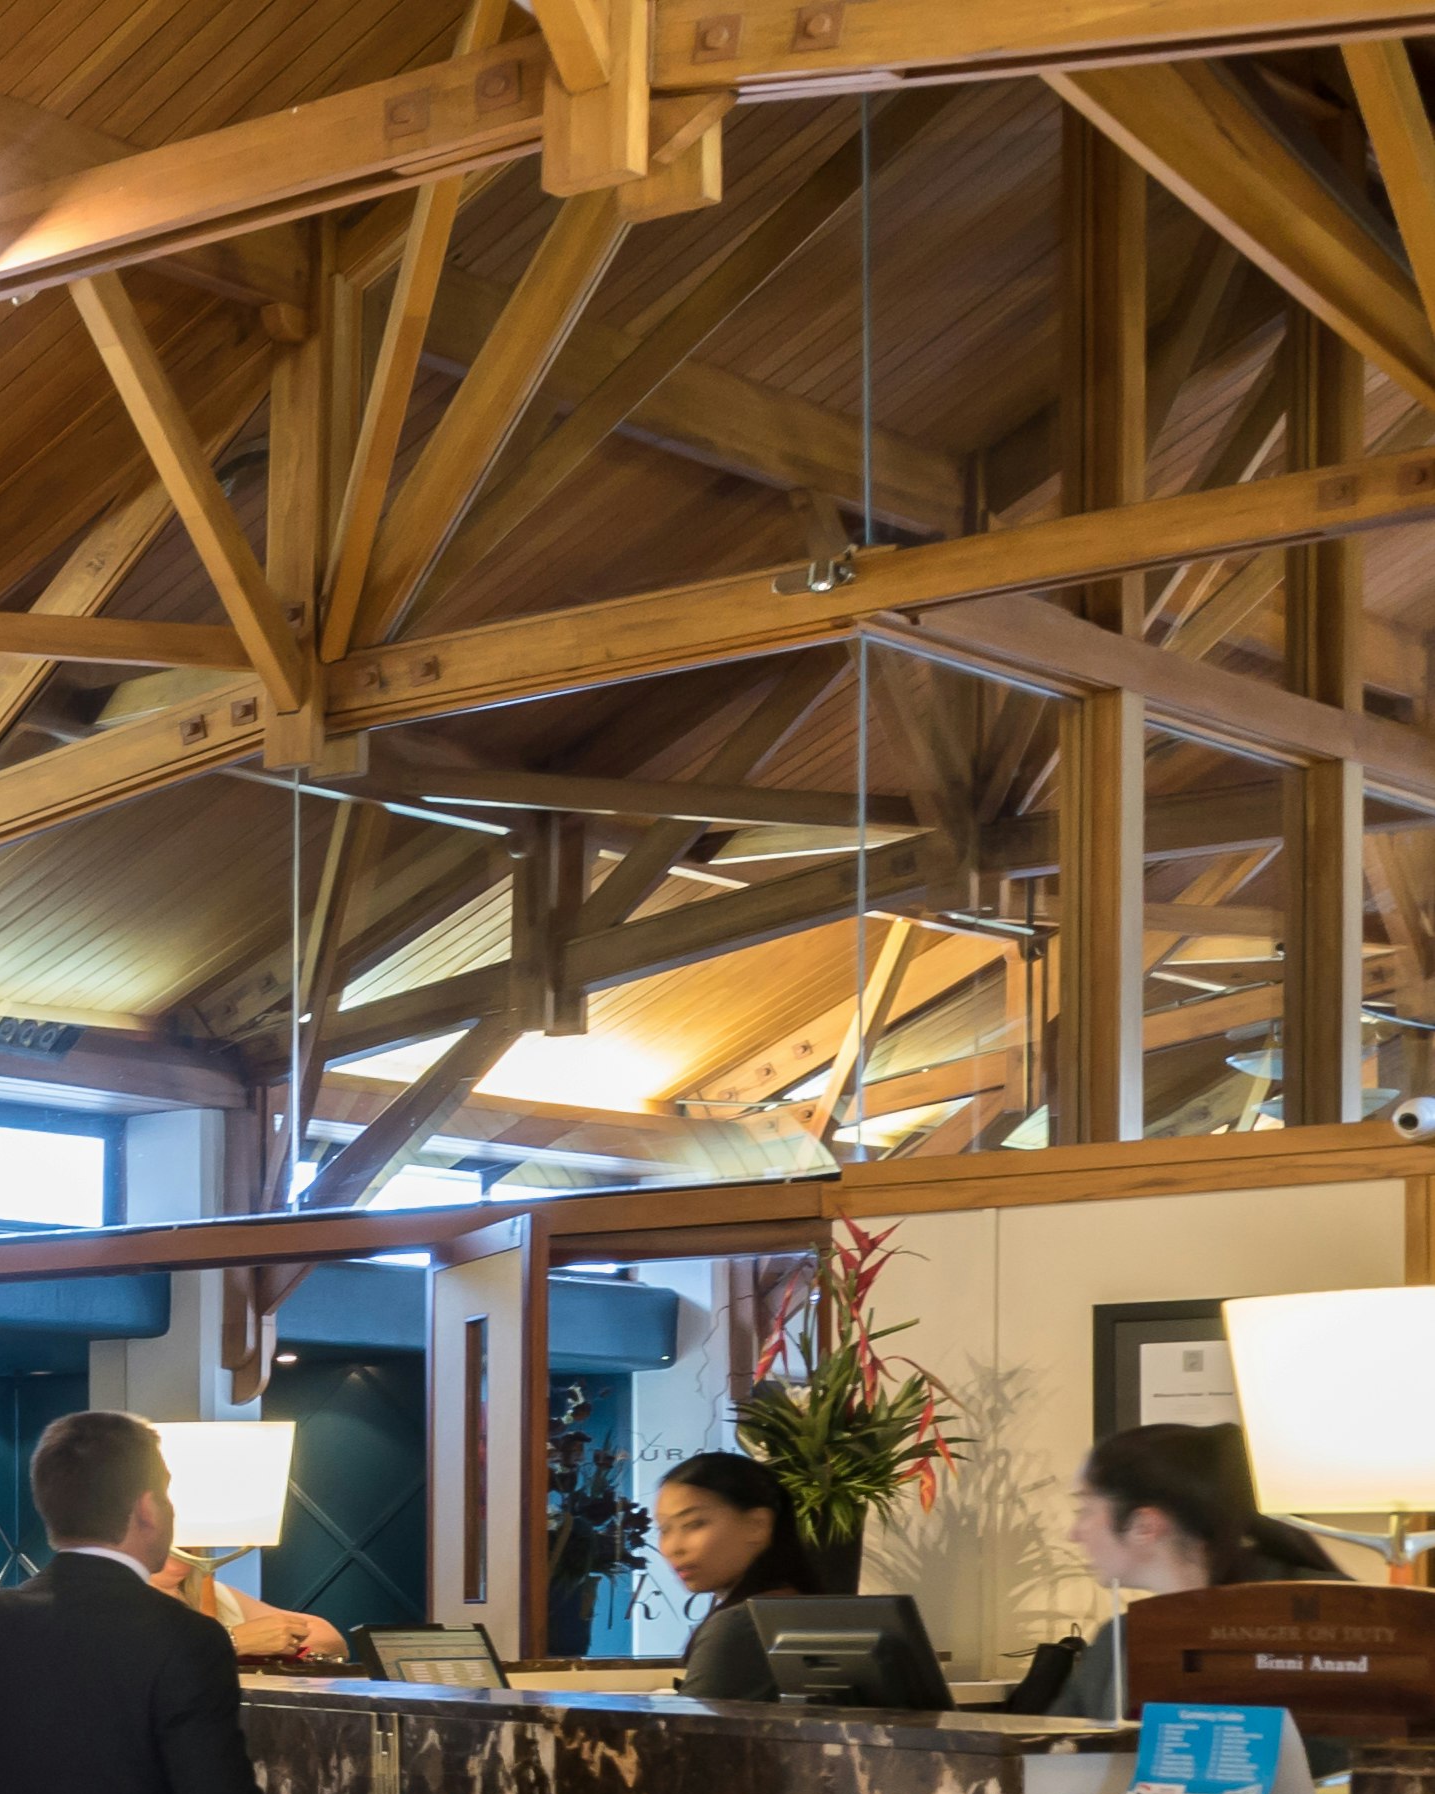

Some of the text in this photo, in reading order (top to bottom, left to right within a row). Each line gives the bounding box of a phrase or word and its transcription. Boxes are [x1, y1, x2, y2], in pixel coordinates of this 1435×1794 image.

[1209, 1624, 1398, 1644] MANAGER ON DUTY
[1309, 1655, 1369, 1673] Anand
